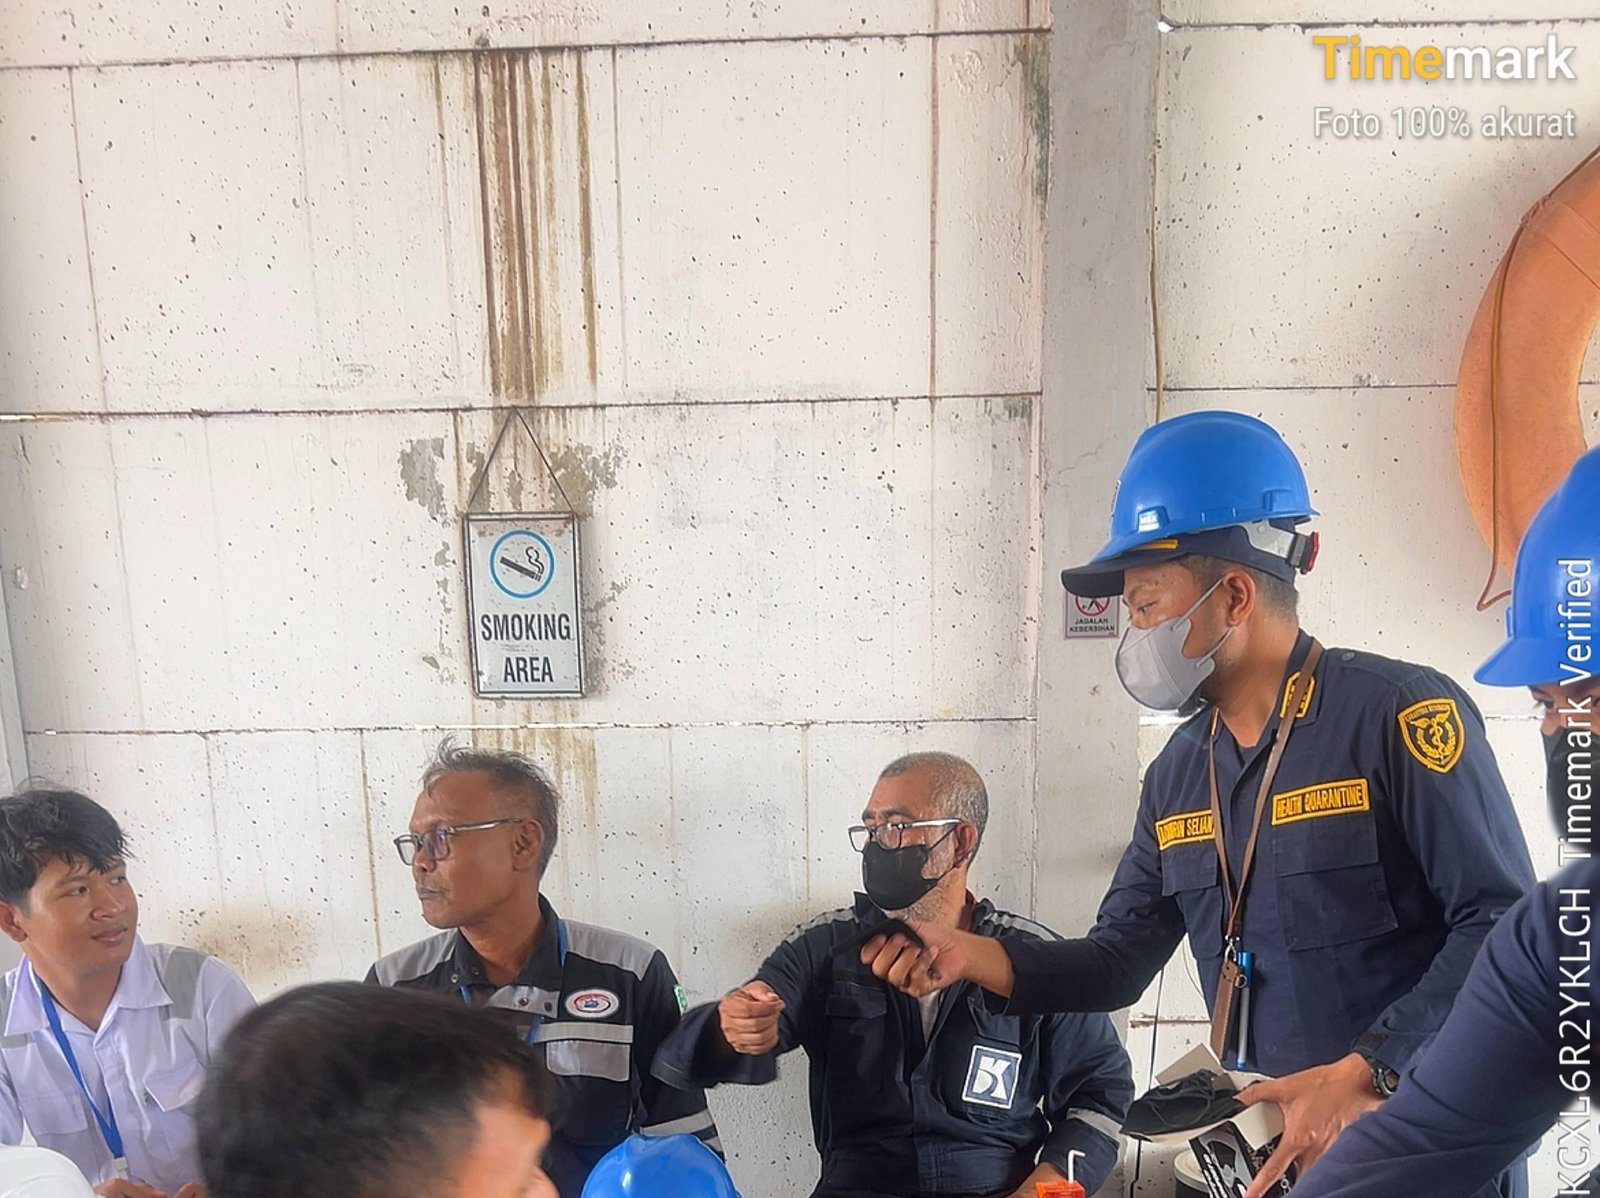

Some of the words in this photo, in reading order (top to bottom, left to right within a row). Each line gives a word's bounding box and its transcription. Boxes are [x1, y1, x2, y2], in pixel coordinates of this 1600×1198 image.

[480, 613, 571, 641] SMOKING
[503, 656, 554, 683] AREA
[1276, 795, 1303, 818] HEALTH
[1304, 785, 1363, 812] QUARANTINE
